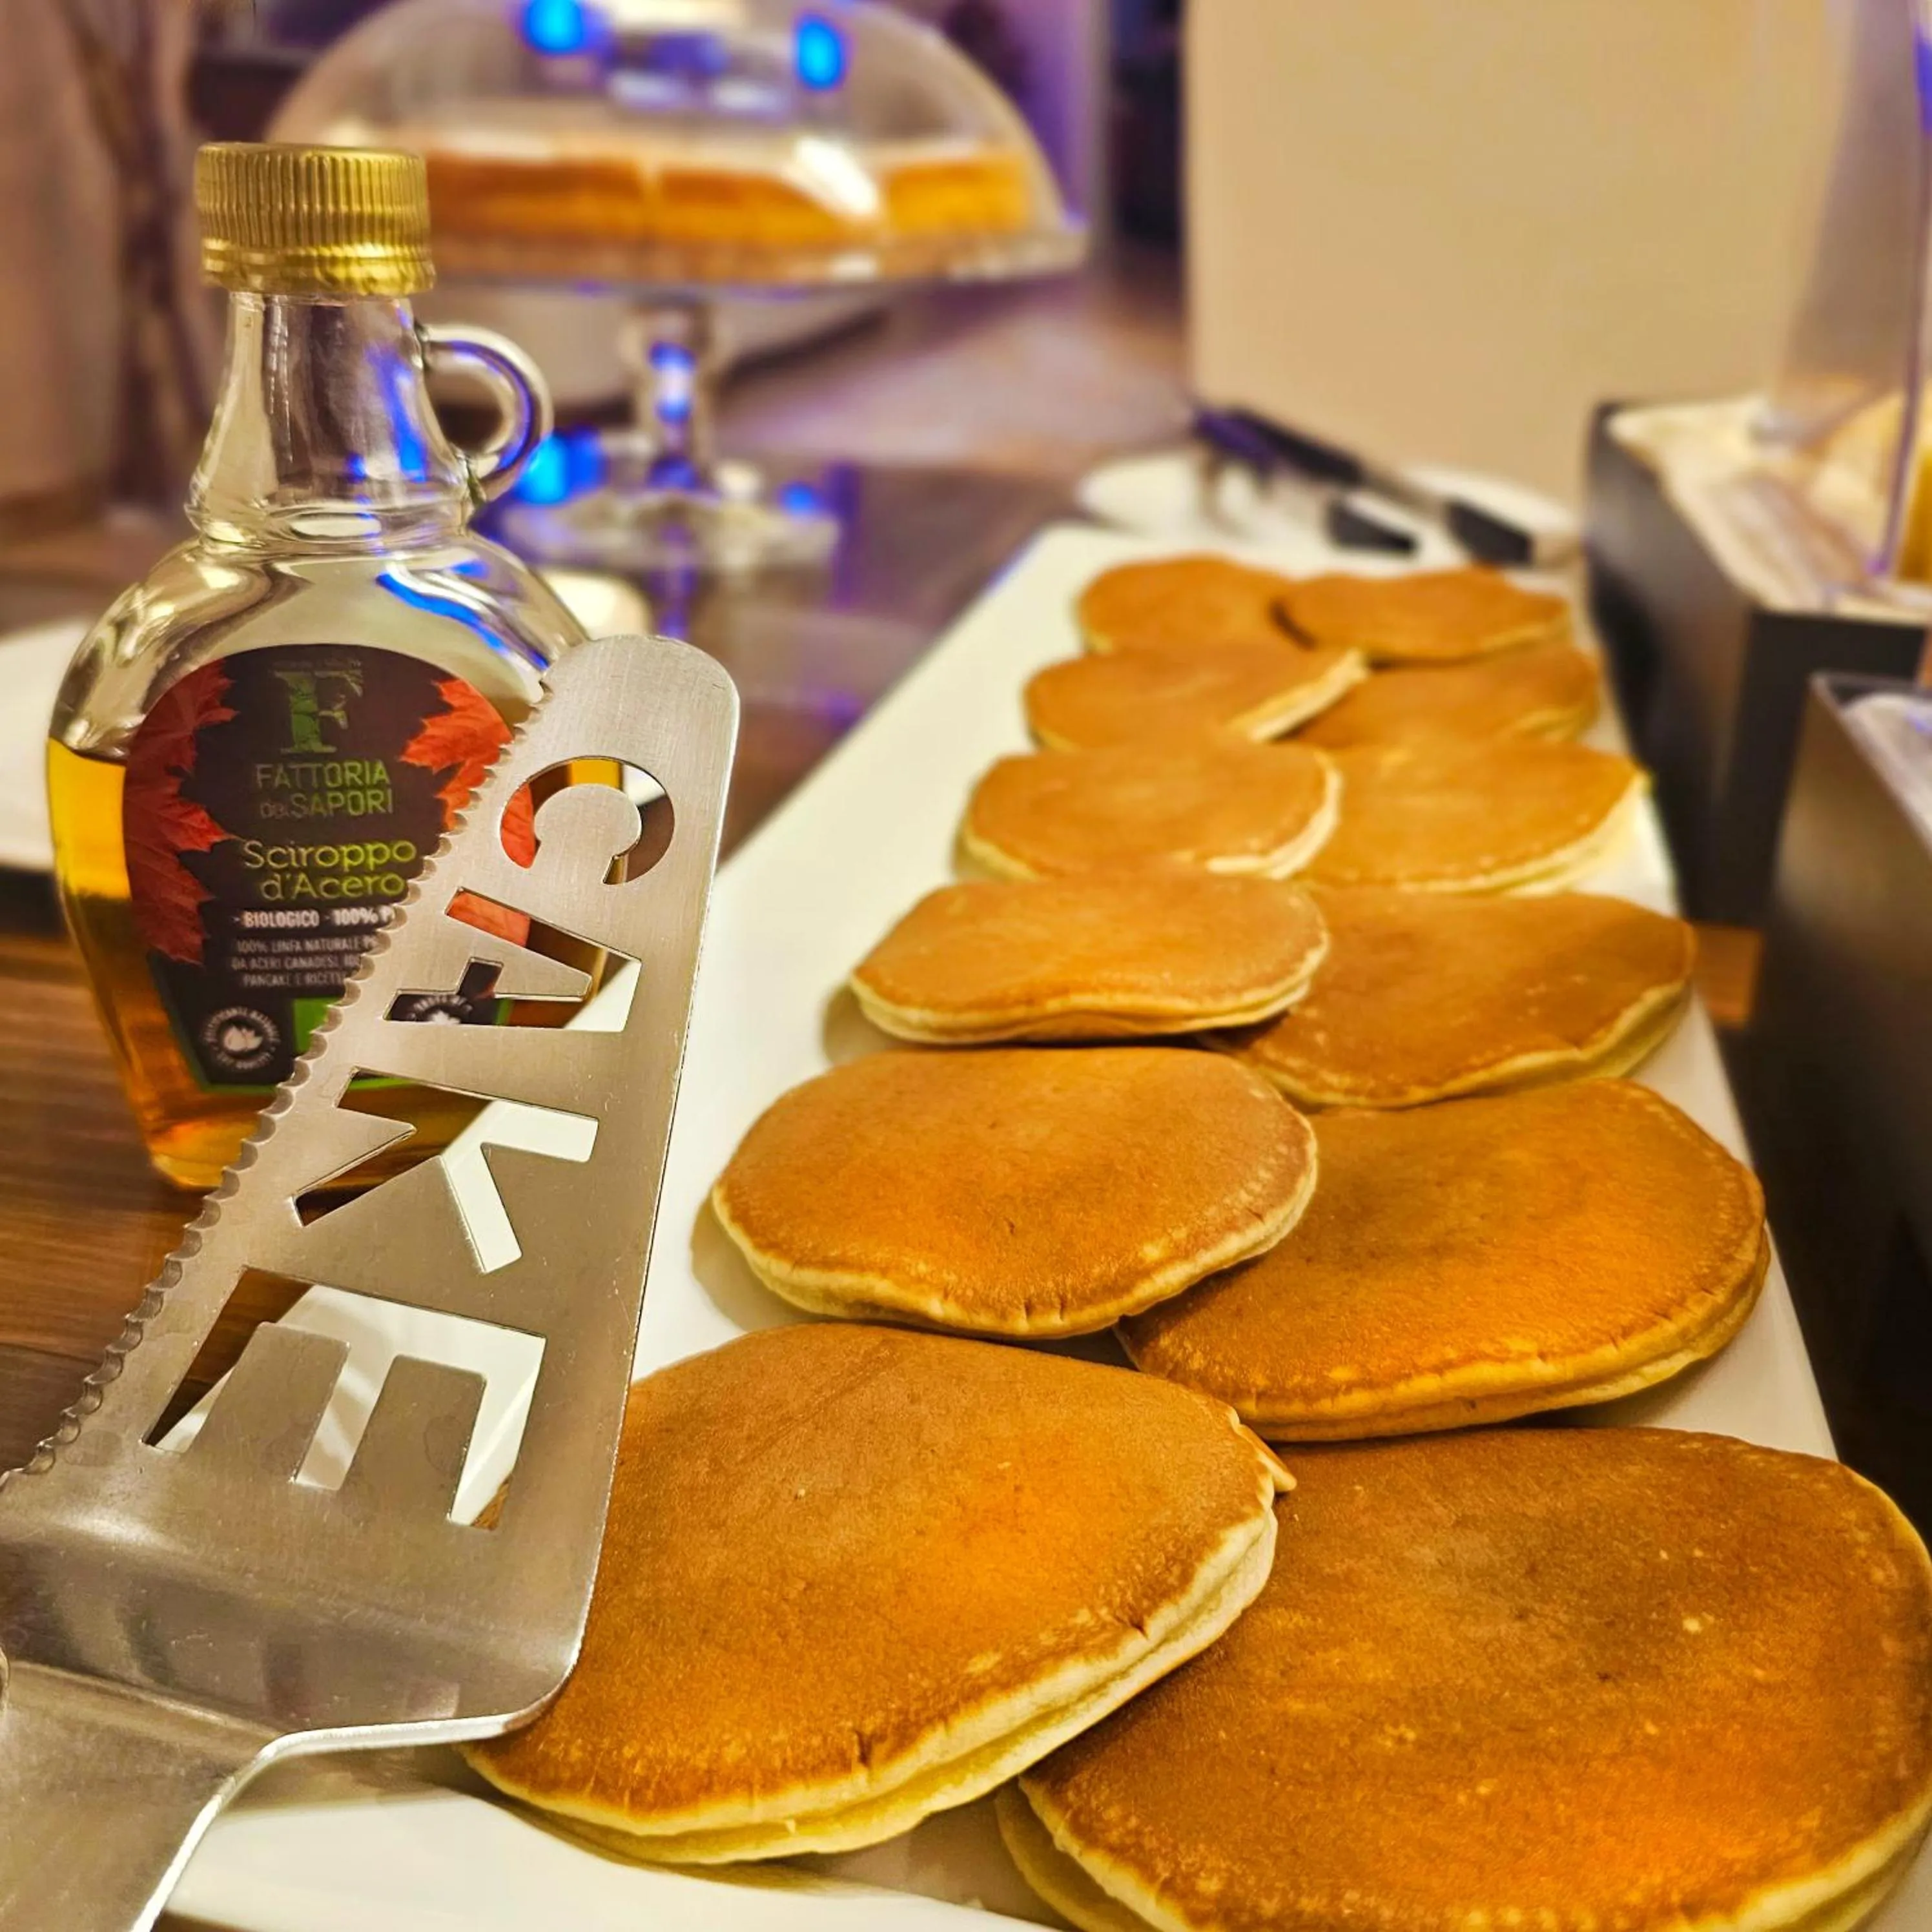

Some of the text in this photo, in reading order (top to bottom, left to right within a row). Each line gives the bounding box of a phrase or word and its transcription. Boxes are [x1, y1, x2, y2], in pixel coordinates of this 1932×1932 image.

[274, 669, 364, 753] F
[256, 760, 390, 788] FATTORIA
[291, 788, 393, 819] SAPORI
[243, 840, 416, 872] Sciroppo
[260, 872, 406, 900] d'Acero
[243, 910, 320, 928] BIOLOGICO
[333, 907, 378, 926] 100%
[143, 755, 675, 1531] CAKE
